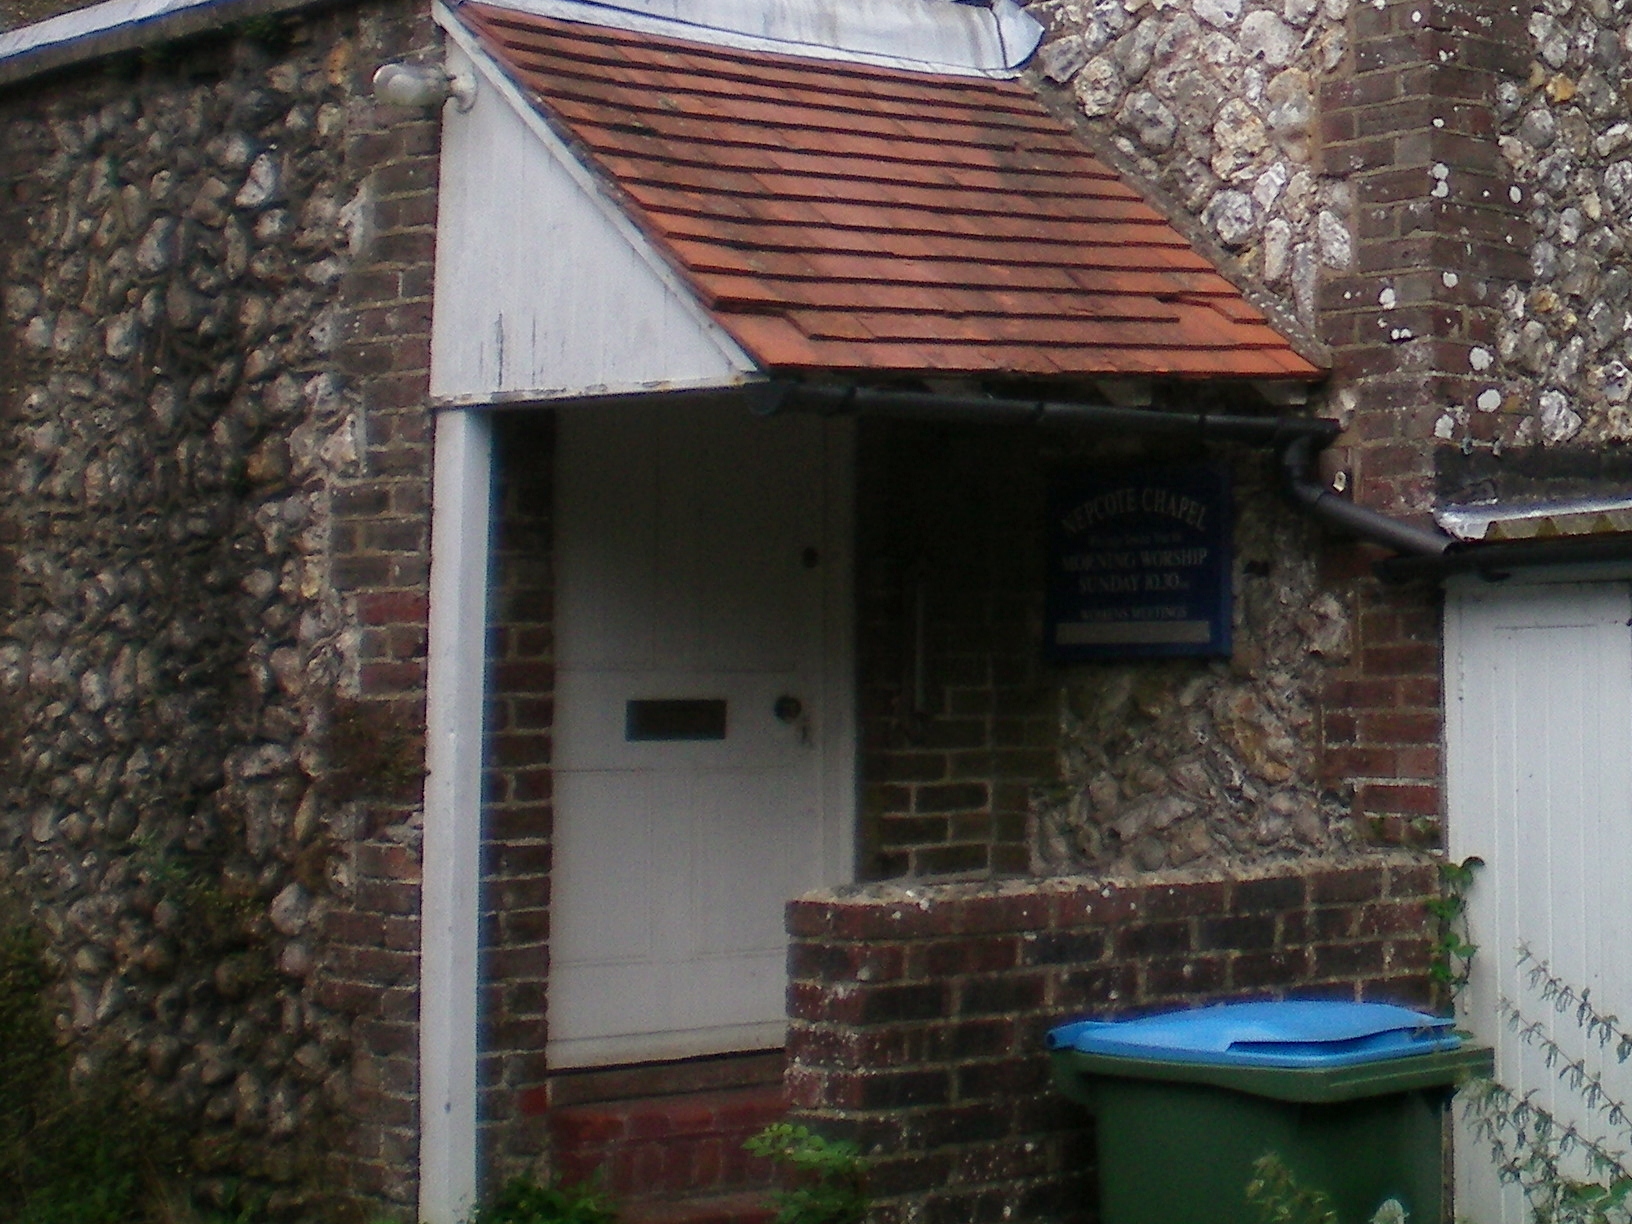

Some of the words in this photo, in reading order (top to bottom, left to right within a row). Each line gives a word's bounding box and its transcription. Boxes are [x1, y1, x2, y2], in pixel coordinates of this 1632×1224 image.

[1141, 487, 1209, 533] CHAPEL
[1061, 551, 1136, 572] MORNING
[1139, 547, 1210, 568] WORSHIP
[1078, 573, 1140, 595] SUNDAY
